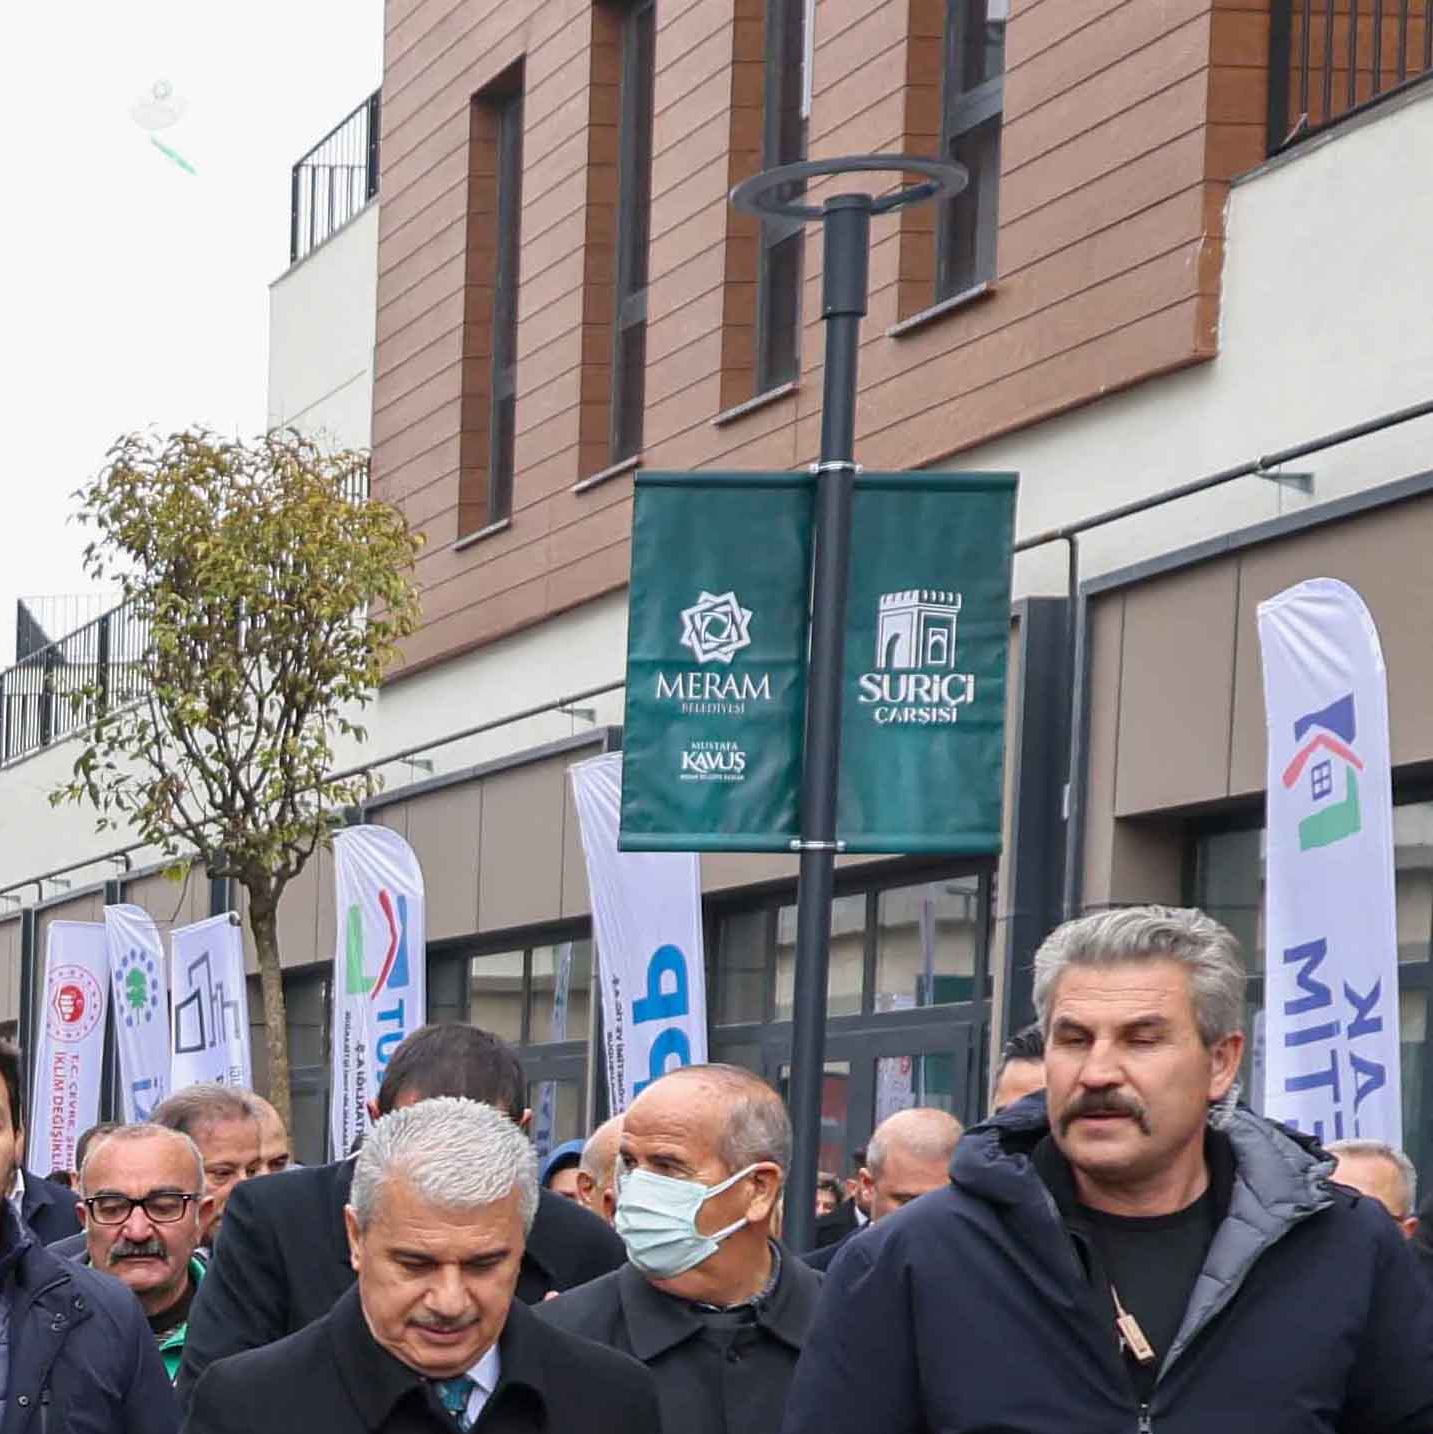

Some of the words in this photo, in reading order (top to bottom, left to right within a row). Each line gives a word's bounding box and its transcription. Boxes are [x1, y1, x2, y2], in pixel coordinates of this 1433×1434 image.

[656, 671, 772, 700] MERAM
[858, 672, 975, 707] SURİÇİ
[681, 751, 747, 774] KAVUŞ
[53, 1052, 68, 1091] İKLİM
